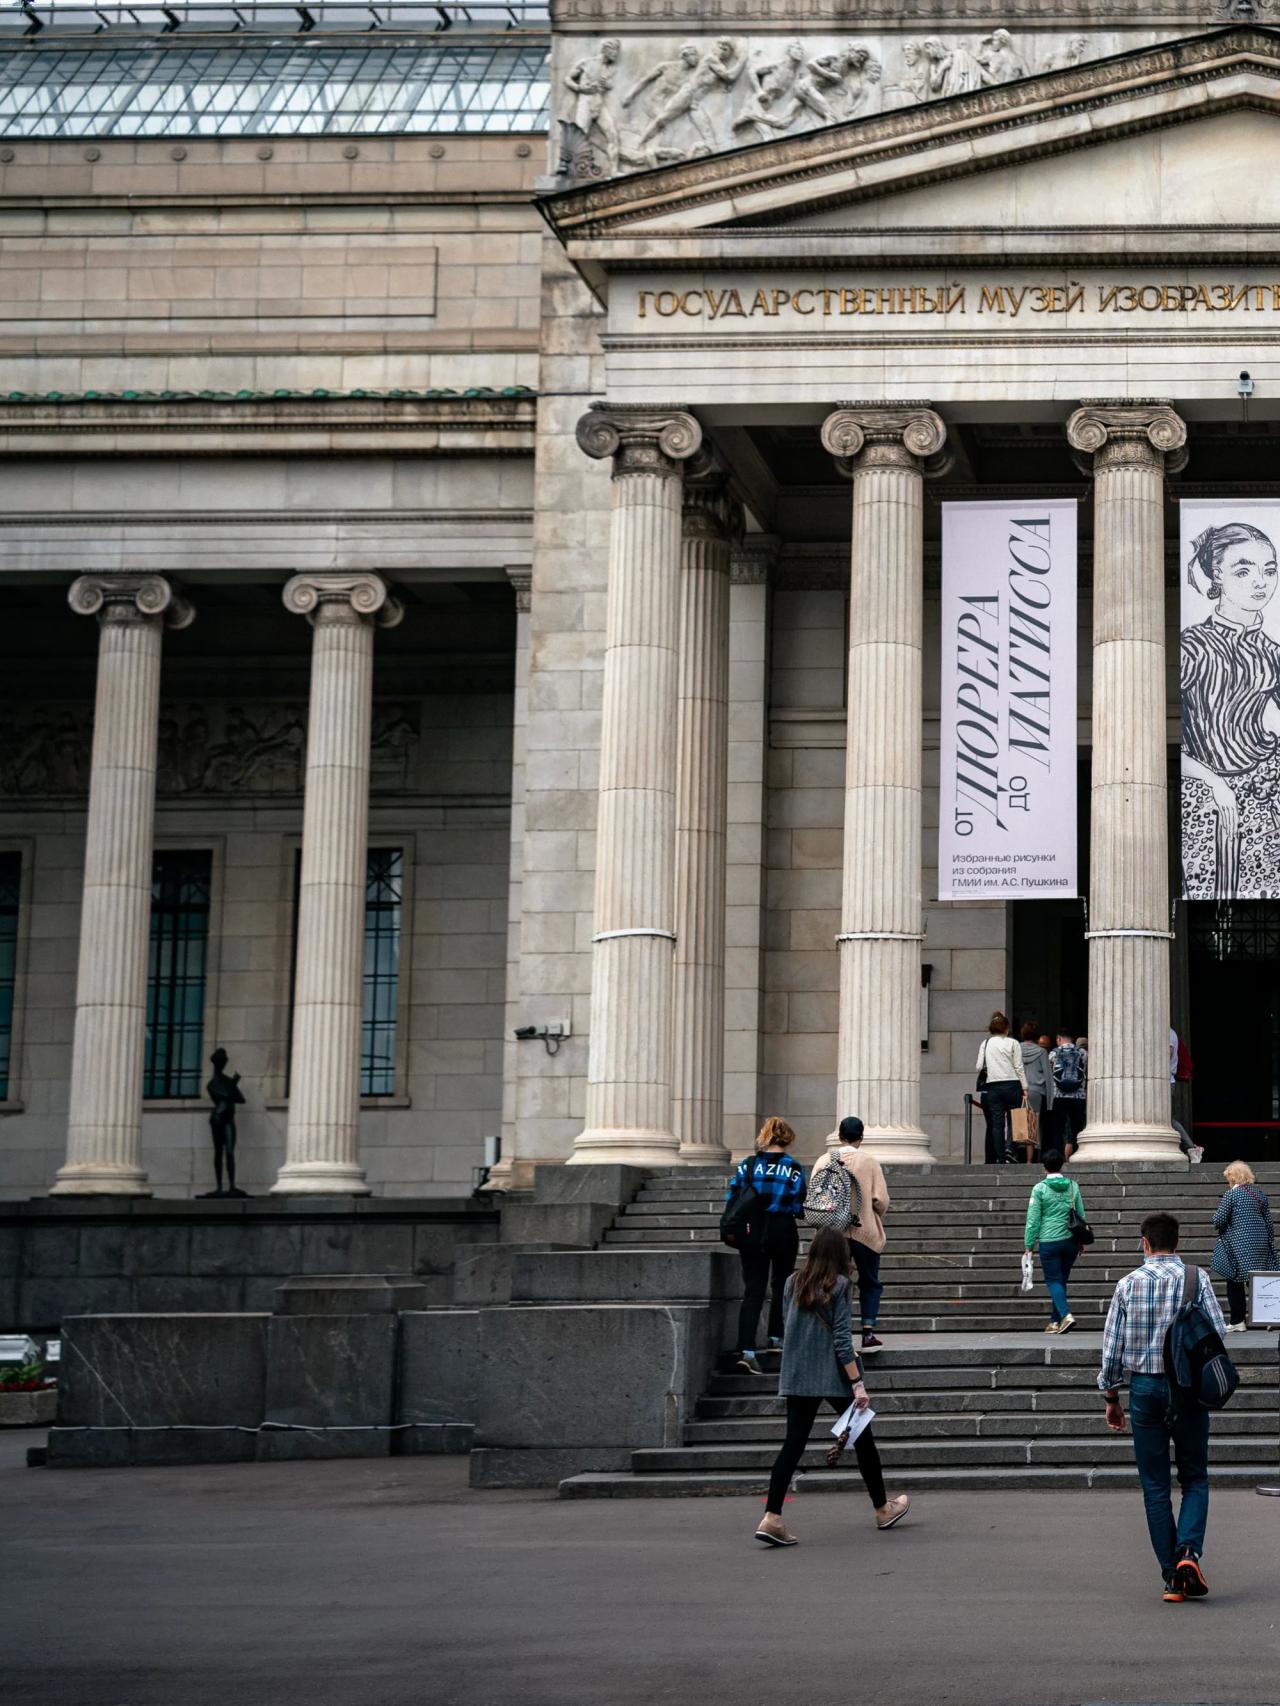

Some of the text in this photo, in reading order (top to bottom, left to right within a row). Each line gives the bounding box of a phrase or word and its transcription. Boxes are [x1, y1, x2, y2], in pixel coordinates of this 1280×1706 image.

[638, 280, 966, 320] ГОСУДАРСТВЕННЫЙ
[977, 280, 1086, 317] МУЗЕЙ
[1008, 512, 1053, 812] ДО МАТИССА
[954, 590, 1010, 837] ОТ ДЮРЕРА
[952, 854, 1056, 864] Избранные рисунки
[952, 866, 1017, 876] из собрания
[952, 878, 982, 887] ГМИИ
[983, 879, 1000, 887] им.
[1021, 877, 1069, 888] Пушкина
